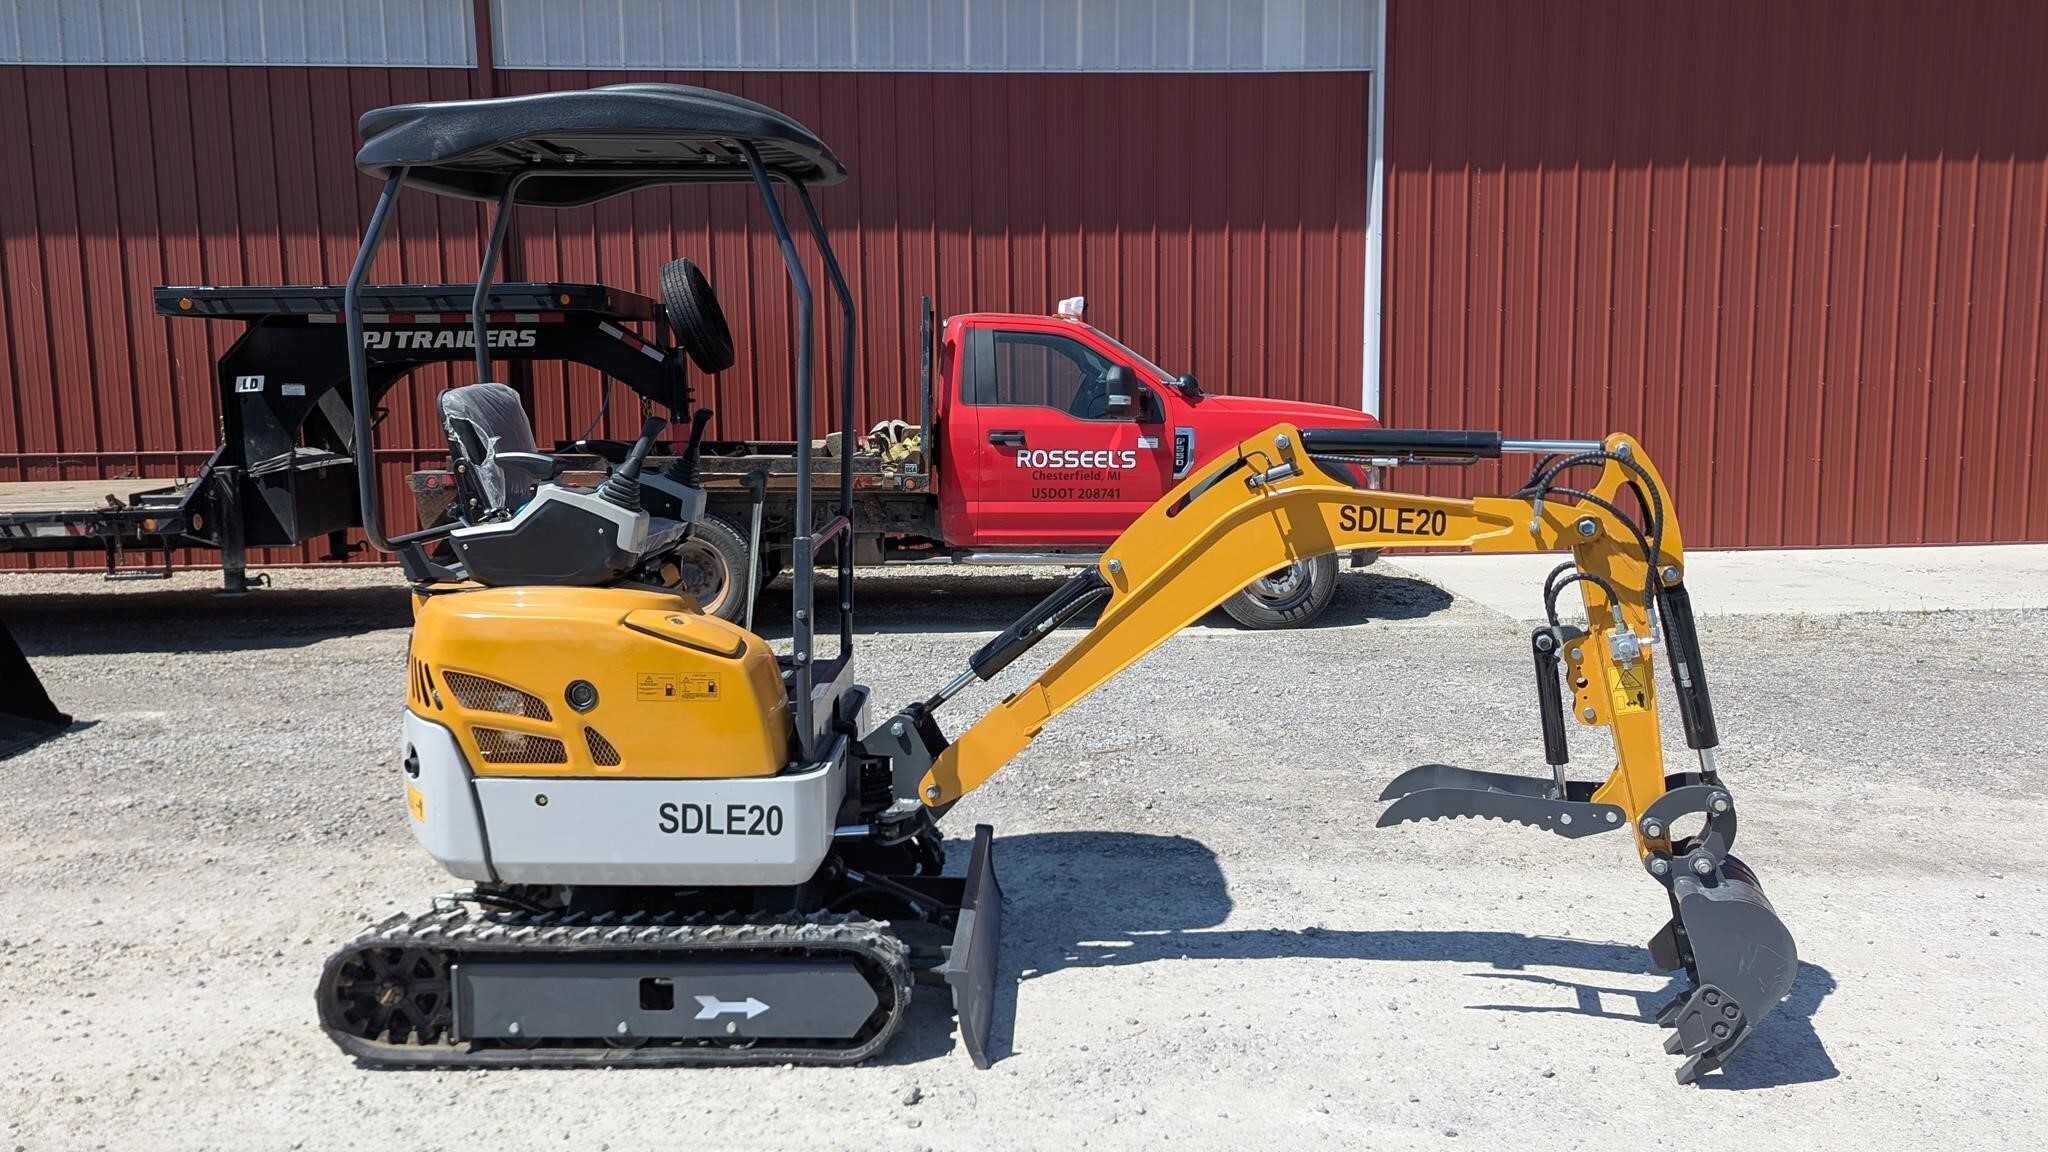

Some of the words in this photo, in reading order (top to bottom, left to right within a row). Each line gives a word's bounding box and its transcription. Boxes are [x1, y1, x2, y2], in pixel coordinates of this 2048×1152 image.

[363, 331, 391, 349] PJ
[397, 330, 537, 349] TRAILERS
[242, 378, 259, 390] LD
[1016, 450, 1136, 468] ROSSEEL'S
[1032, 471, 1105, 481] Chesterfield,
[1107, 472, 1121, 481] MI
[1031, 488, 1073, 499] USDOT
[1078, 488, 1120, 499] 208741
[1339, 505, 1446, 536] SDLE20
[658, 802, 783, 836] SDLE20
